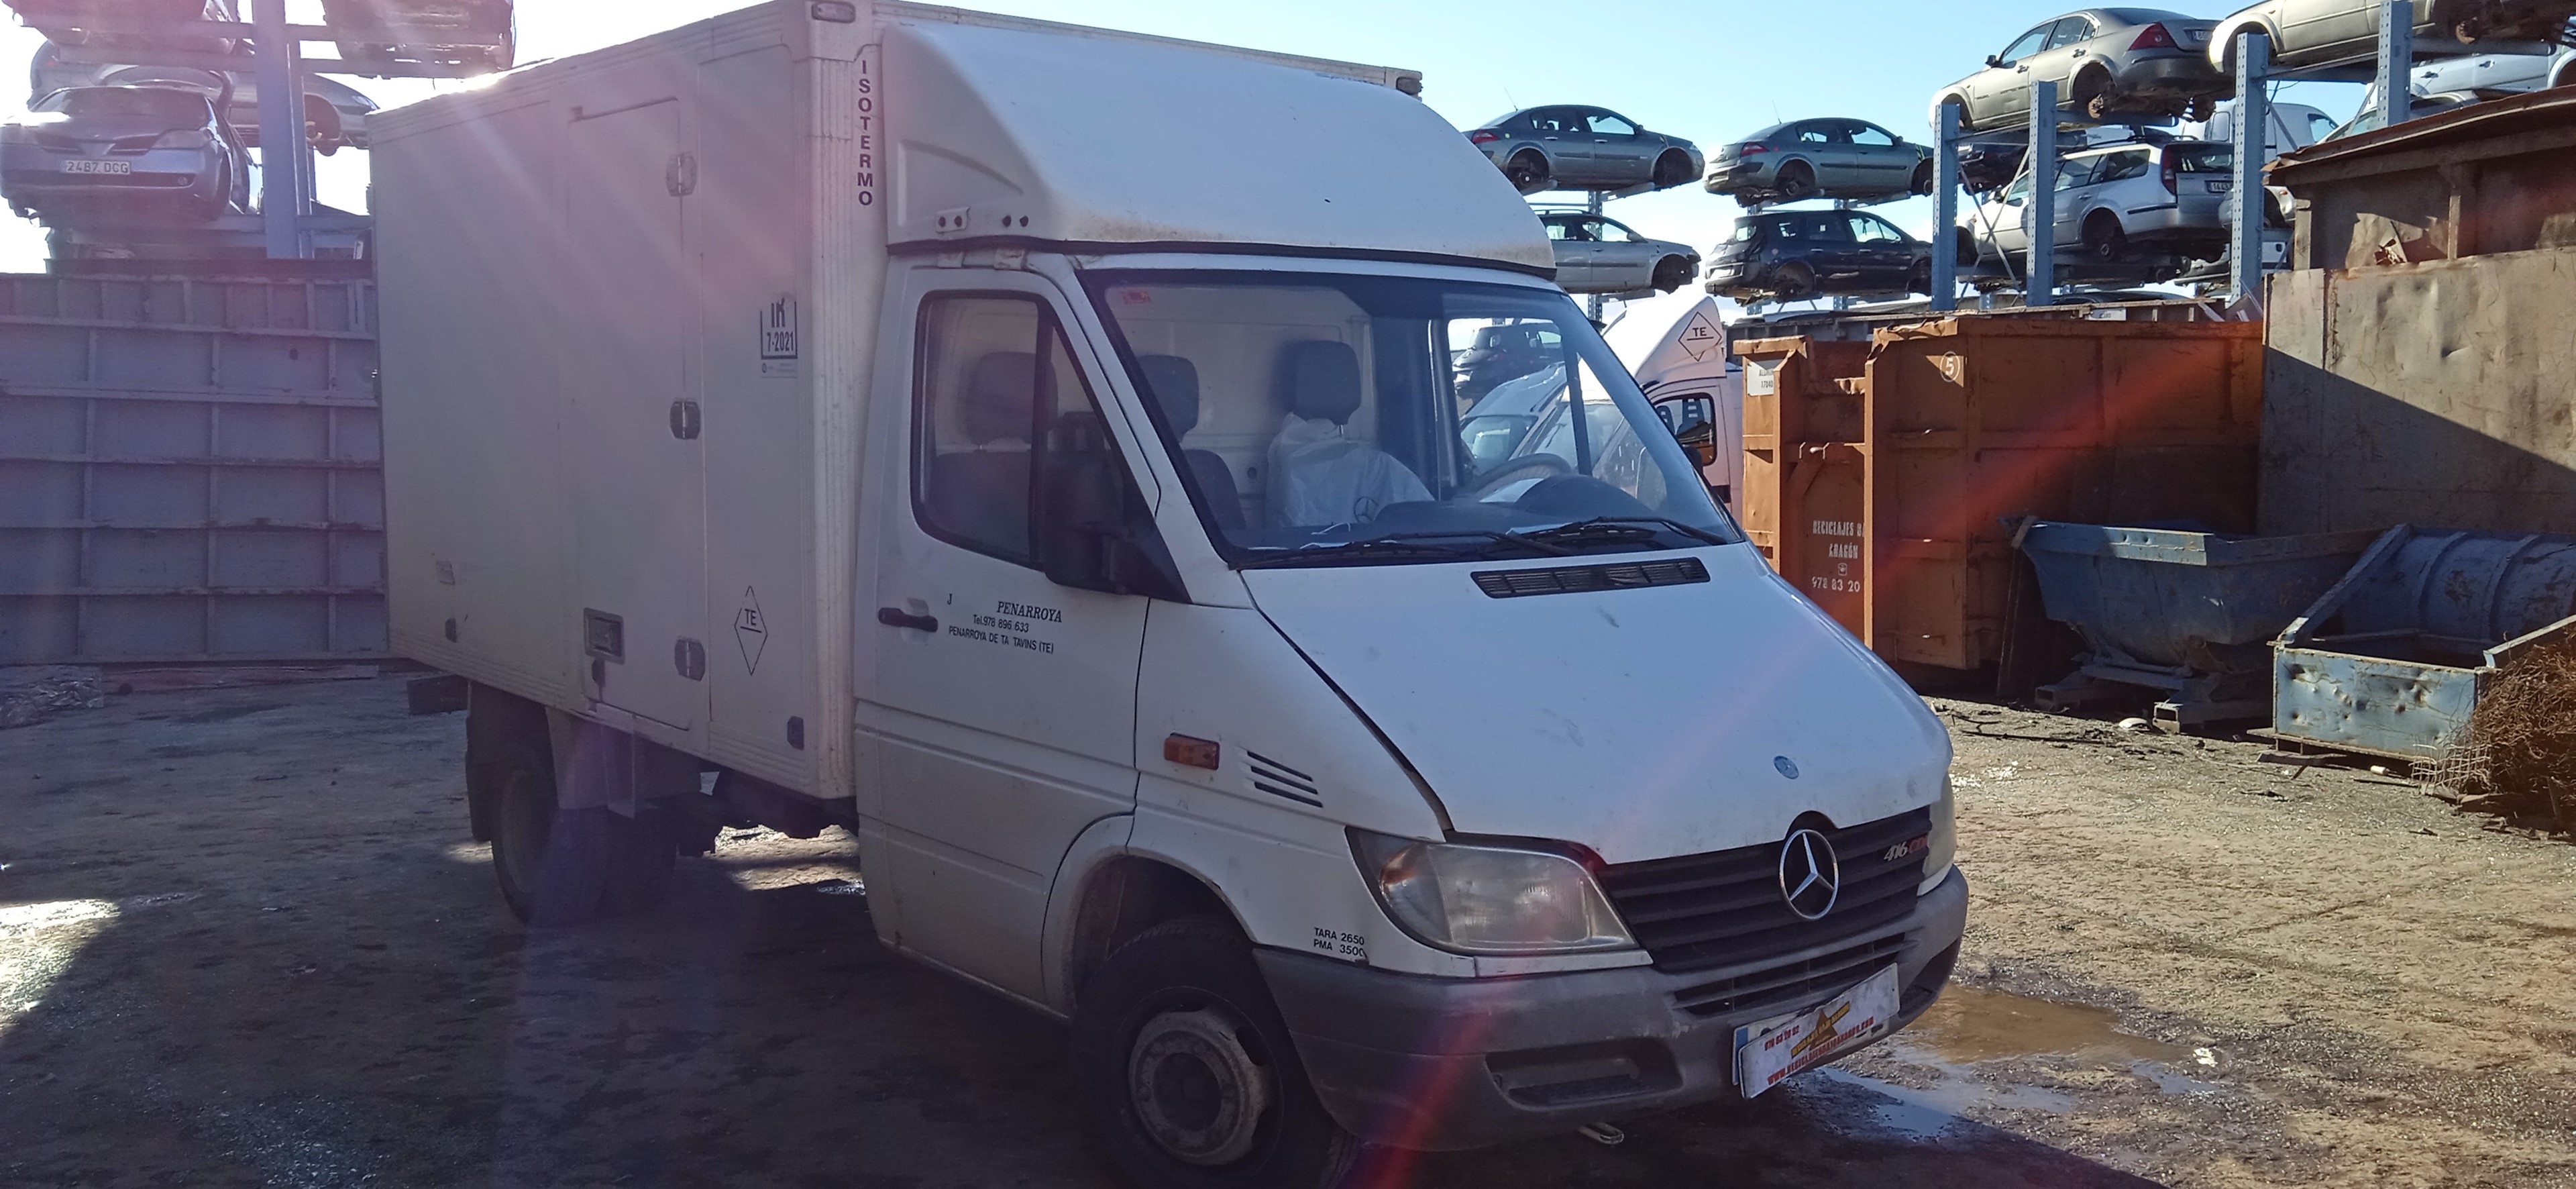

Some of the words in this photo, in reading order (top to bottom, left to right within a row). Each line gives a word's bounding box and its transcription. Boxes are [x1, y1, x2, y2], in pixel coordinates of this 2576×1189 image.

[857, 60, 873, 206] ISOTERMO
[1693, 327, 1707, 337] TE
[1945, 357, 1954, 376] 5
[1812, 576, 1827, 589] 978
[1831, 578, 1843, 590] 83
[1847, 580, 1860, 592] 20
[745, 609, 756, 626] TE
[998, 619, 1012, 630] 896
[1014, 621, 1029, 633] 633
[989, 632, 998, 643] DE
[1013, 637, 1037, 650] TAVINS
[1038, 641, 1054, 654] (TE)
[1883, 841, 1909, 862] 416
[1314, 927, 1337, 940] TARA
[1341, 933, 1364, 945] 2650
[1313, 939, 1332, 951] PMA
